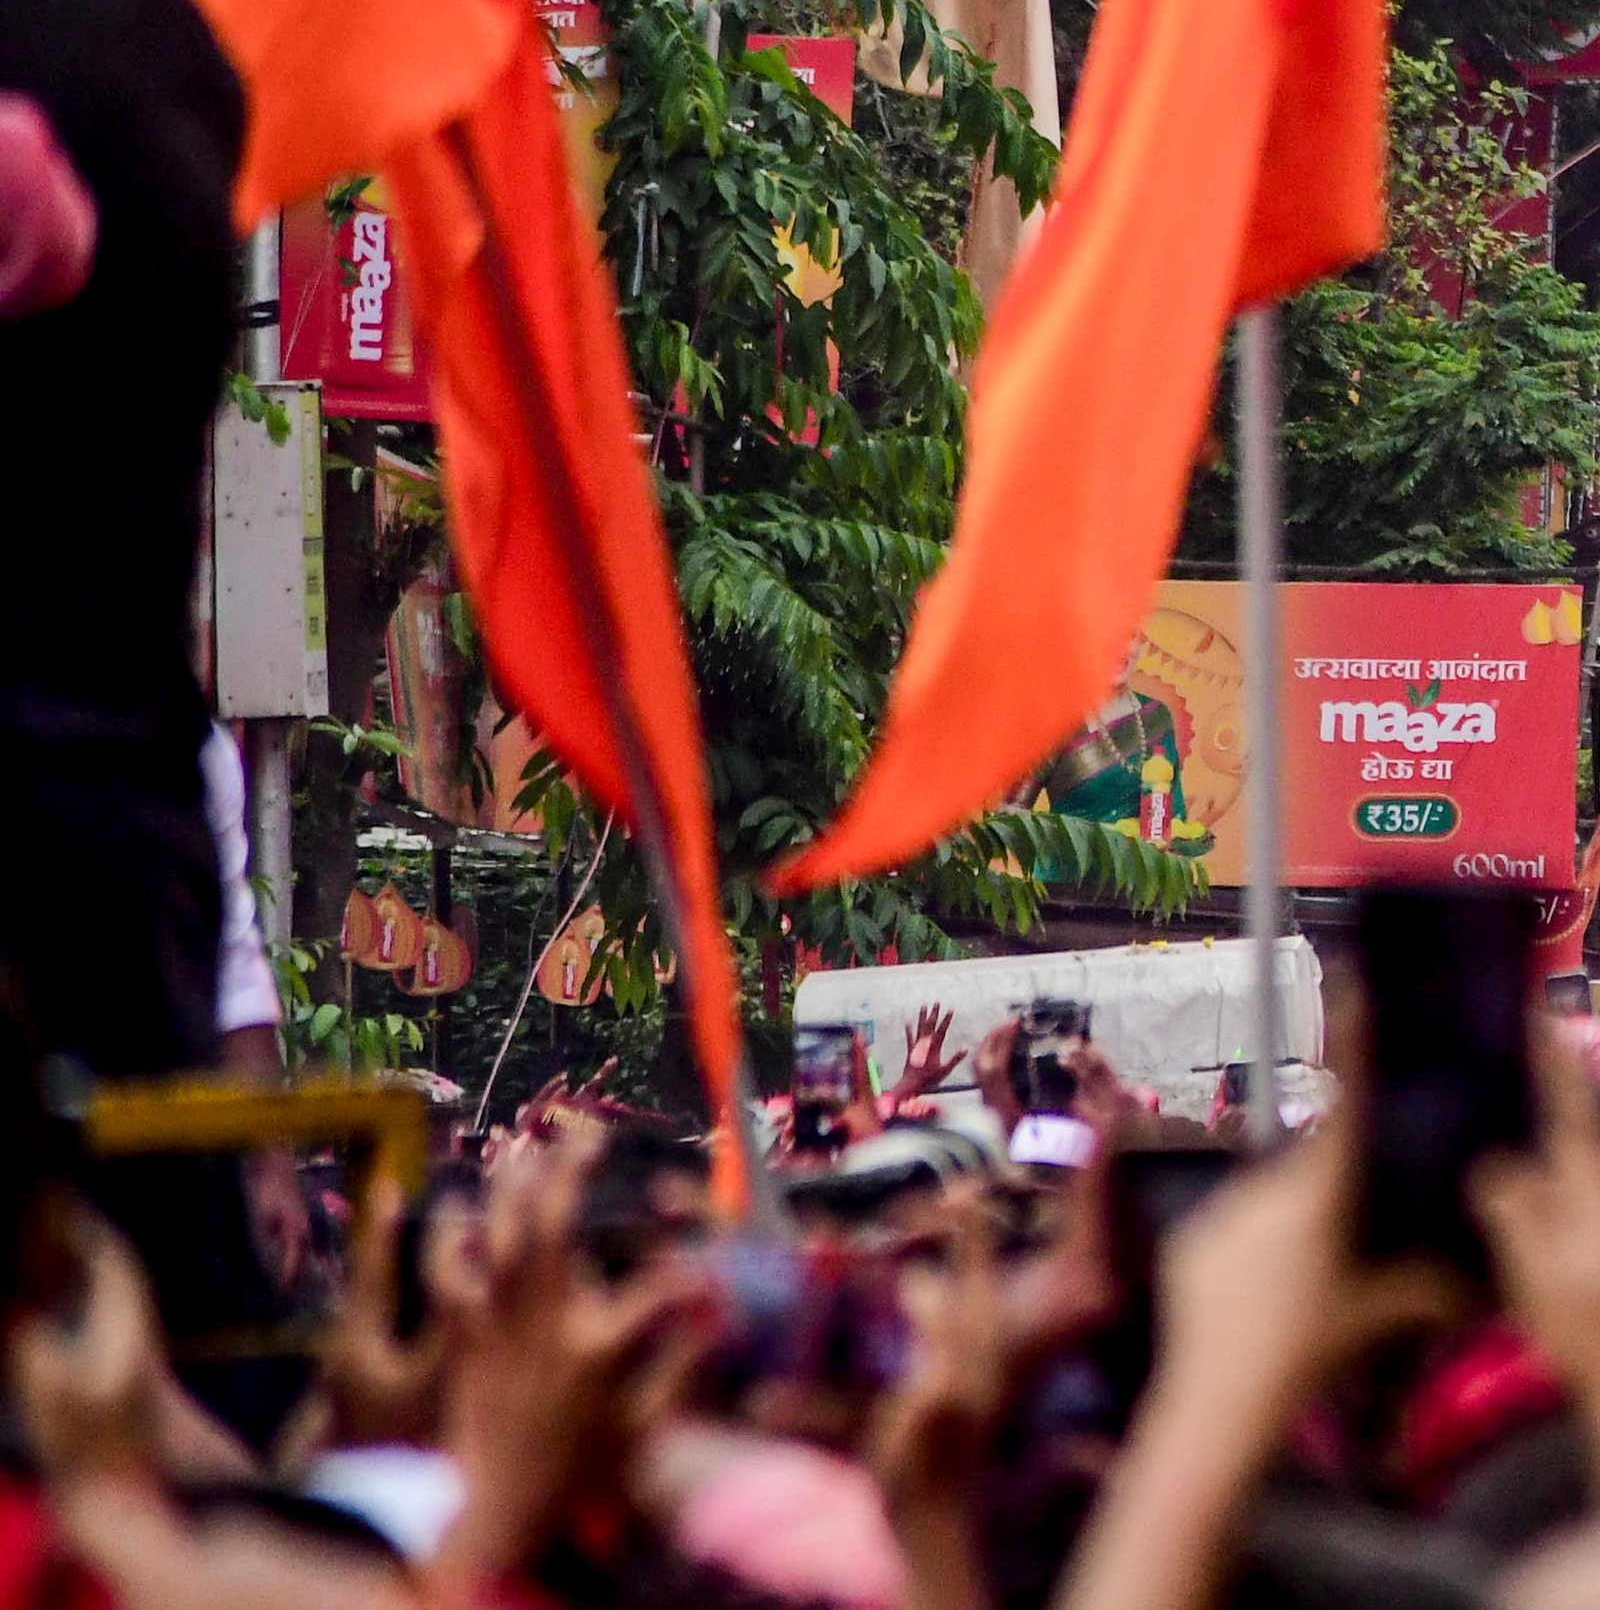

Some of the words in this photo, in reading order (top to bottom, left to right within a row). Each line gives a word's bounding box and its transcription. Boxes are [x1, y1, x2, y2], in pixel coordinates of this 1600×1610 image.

[350, 212, 391, 361] maaza
[1294, 658, 1421, 681] उत्सवाच्या
[1425, 652, 1528, 682] आनंदात
[1320, 701, 1497, 753] maaza
[1361, 751, 1415, 781] होऊ
[1421, 759, 1453, 780] द्या
[1453, 853, 1545, 879] 600ml
